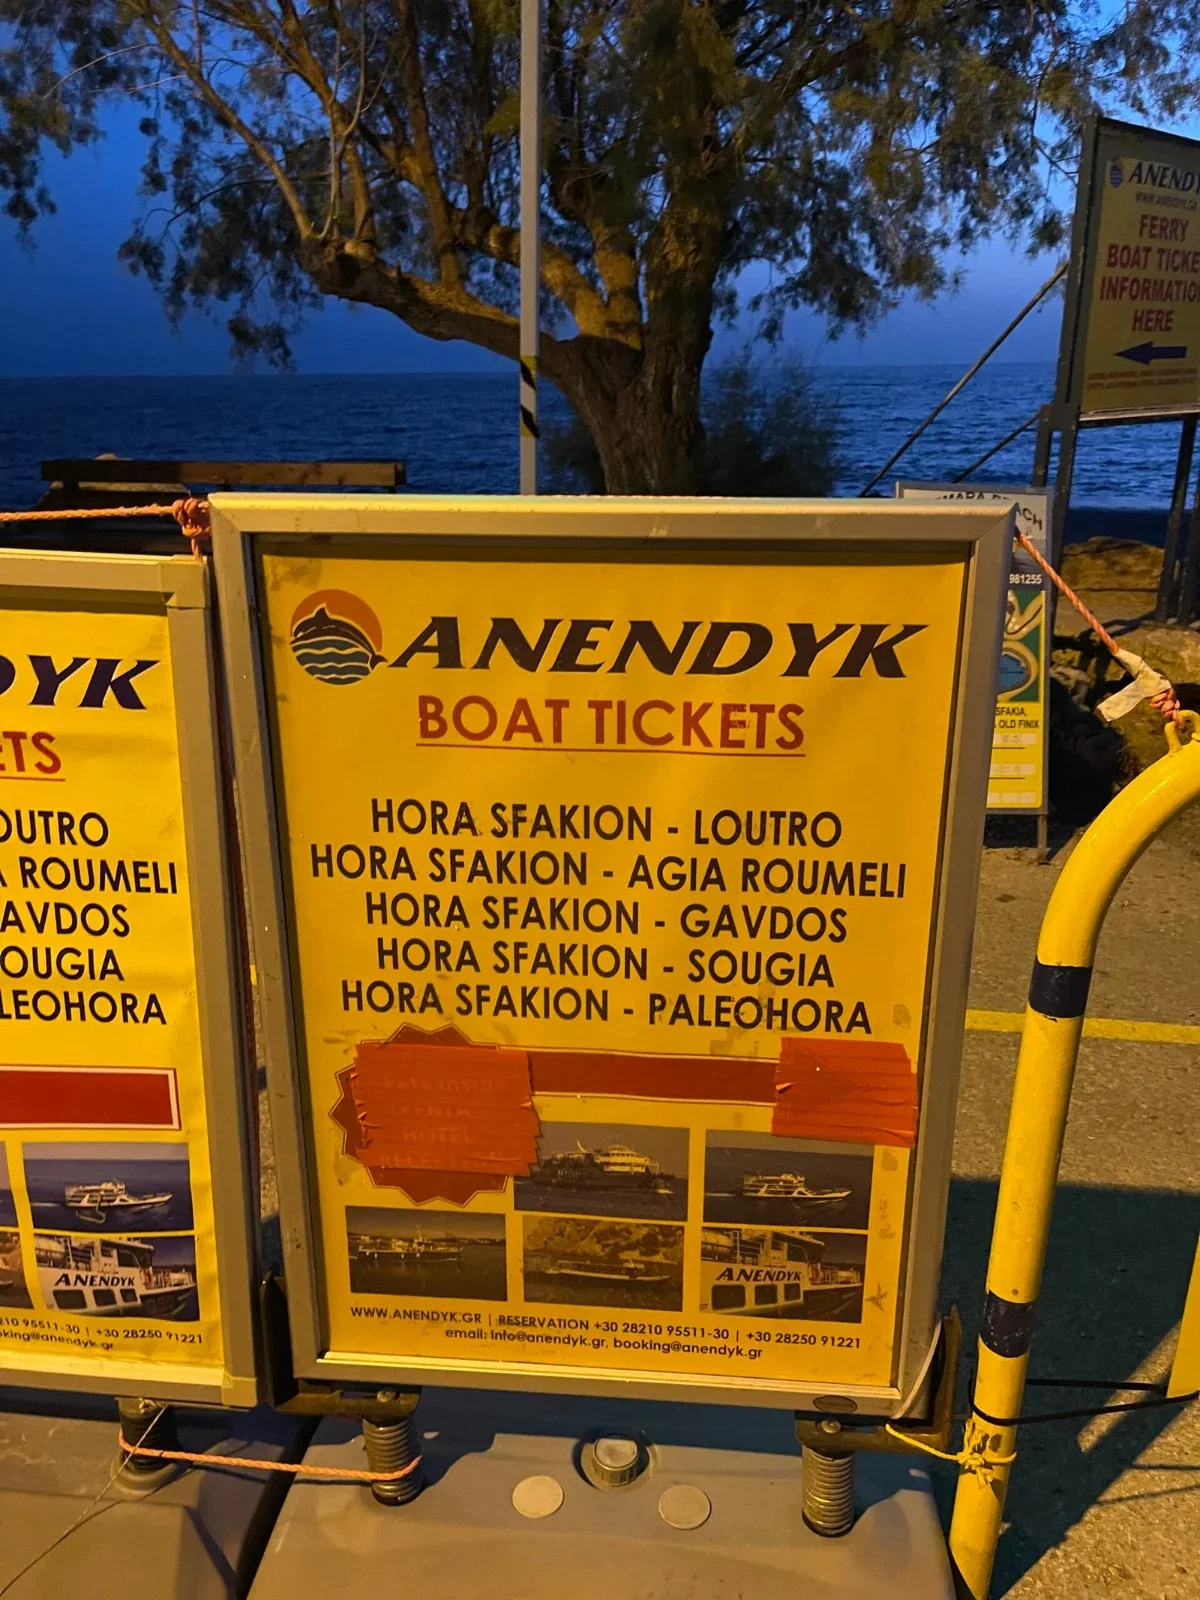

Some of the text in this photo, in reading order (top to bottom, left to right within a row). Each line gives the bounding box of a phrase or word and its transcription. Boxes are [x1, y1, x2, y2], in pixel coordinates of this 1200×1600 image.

[1139, 214, 1190, 242] FERRY
[1107, 243, 1152, 268] BOAT
[1100, 276, 1200, 303] INFORMATIO
[1132, 309, 1174, 332] HERE
[1009, 573, 1042, 584] 981255
[387, 616, 930, 678] ANENDYK
[0, 653, 161, 710] YK
[418, 695, 805, 750] BOAT TICKETS
[999, 719, 1016, 728] OLD
[0, 731, 62, 775] TS
[371, 798, 842, 848] HORA SFAKION - LOUTRO
[19, 856, 178, 894] ROUMELI
[310, 843, 906, 898] HORA SFAKION - AGIA ROUMELI
[365, 891, 847, 943] HORA SFAKION - GAVDOS
[377, 937, 835, 988] HORA SFAKION - SOUGIA
[341, 979, 872, 1034] HORA SFAKION - PALEOHORA
[55, 1273, 135, 1287] ANENDYK
[715, 1267, 802, 1282] ANENDYK
[22, 1318, 80, 1335] 95511-30
[96, 1328, 119, 1338] +30
[122, 1329, 163, 1339] 28250
[166, 1331, 203, 1344] 91221
[350, 1306, 482, 1324] WWW.ANENDYK.GR
[499, 1314, 590, 1331] RESERVATION
[594, 1321, 618, 1333] +30
[622, 1322, 663, 1336] 28210
[667, 1325, 729, 1340] 95511-30
[746, 1331, 771, 1343] +30
[776, 1332, 817, 1346] 28250
[821, 1335, 862, 1349] 91221
[445, 1328, 488, 1341] email:
[613, 1337, 763, 1358] booking@anendyk.gr
